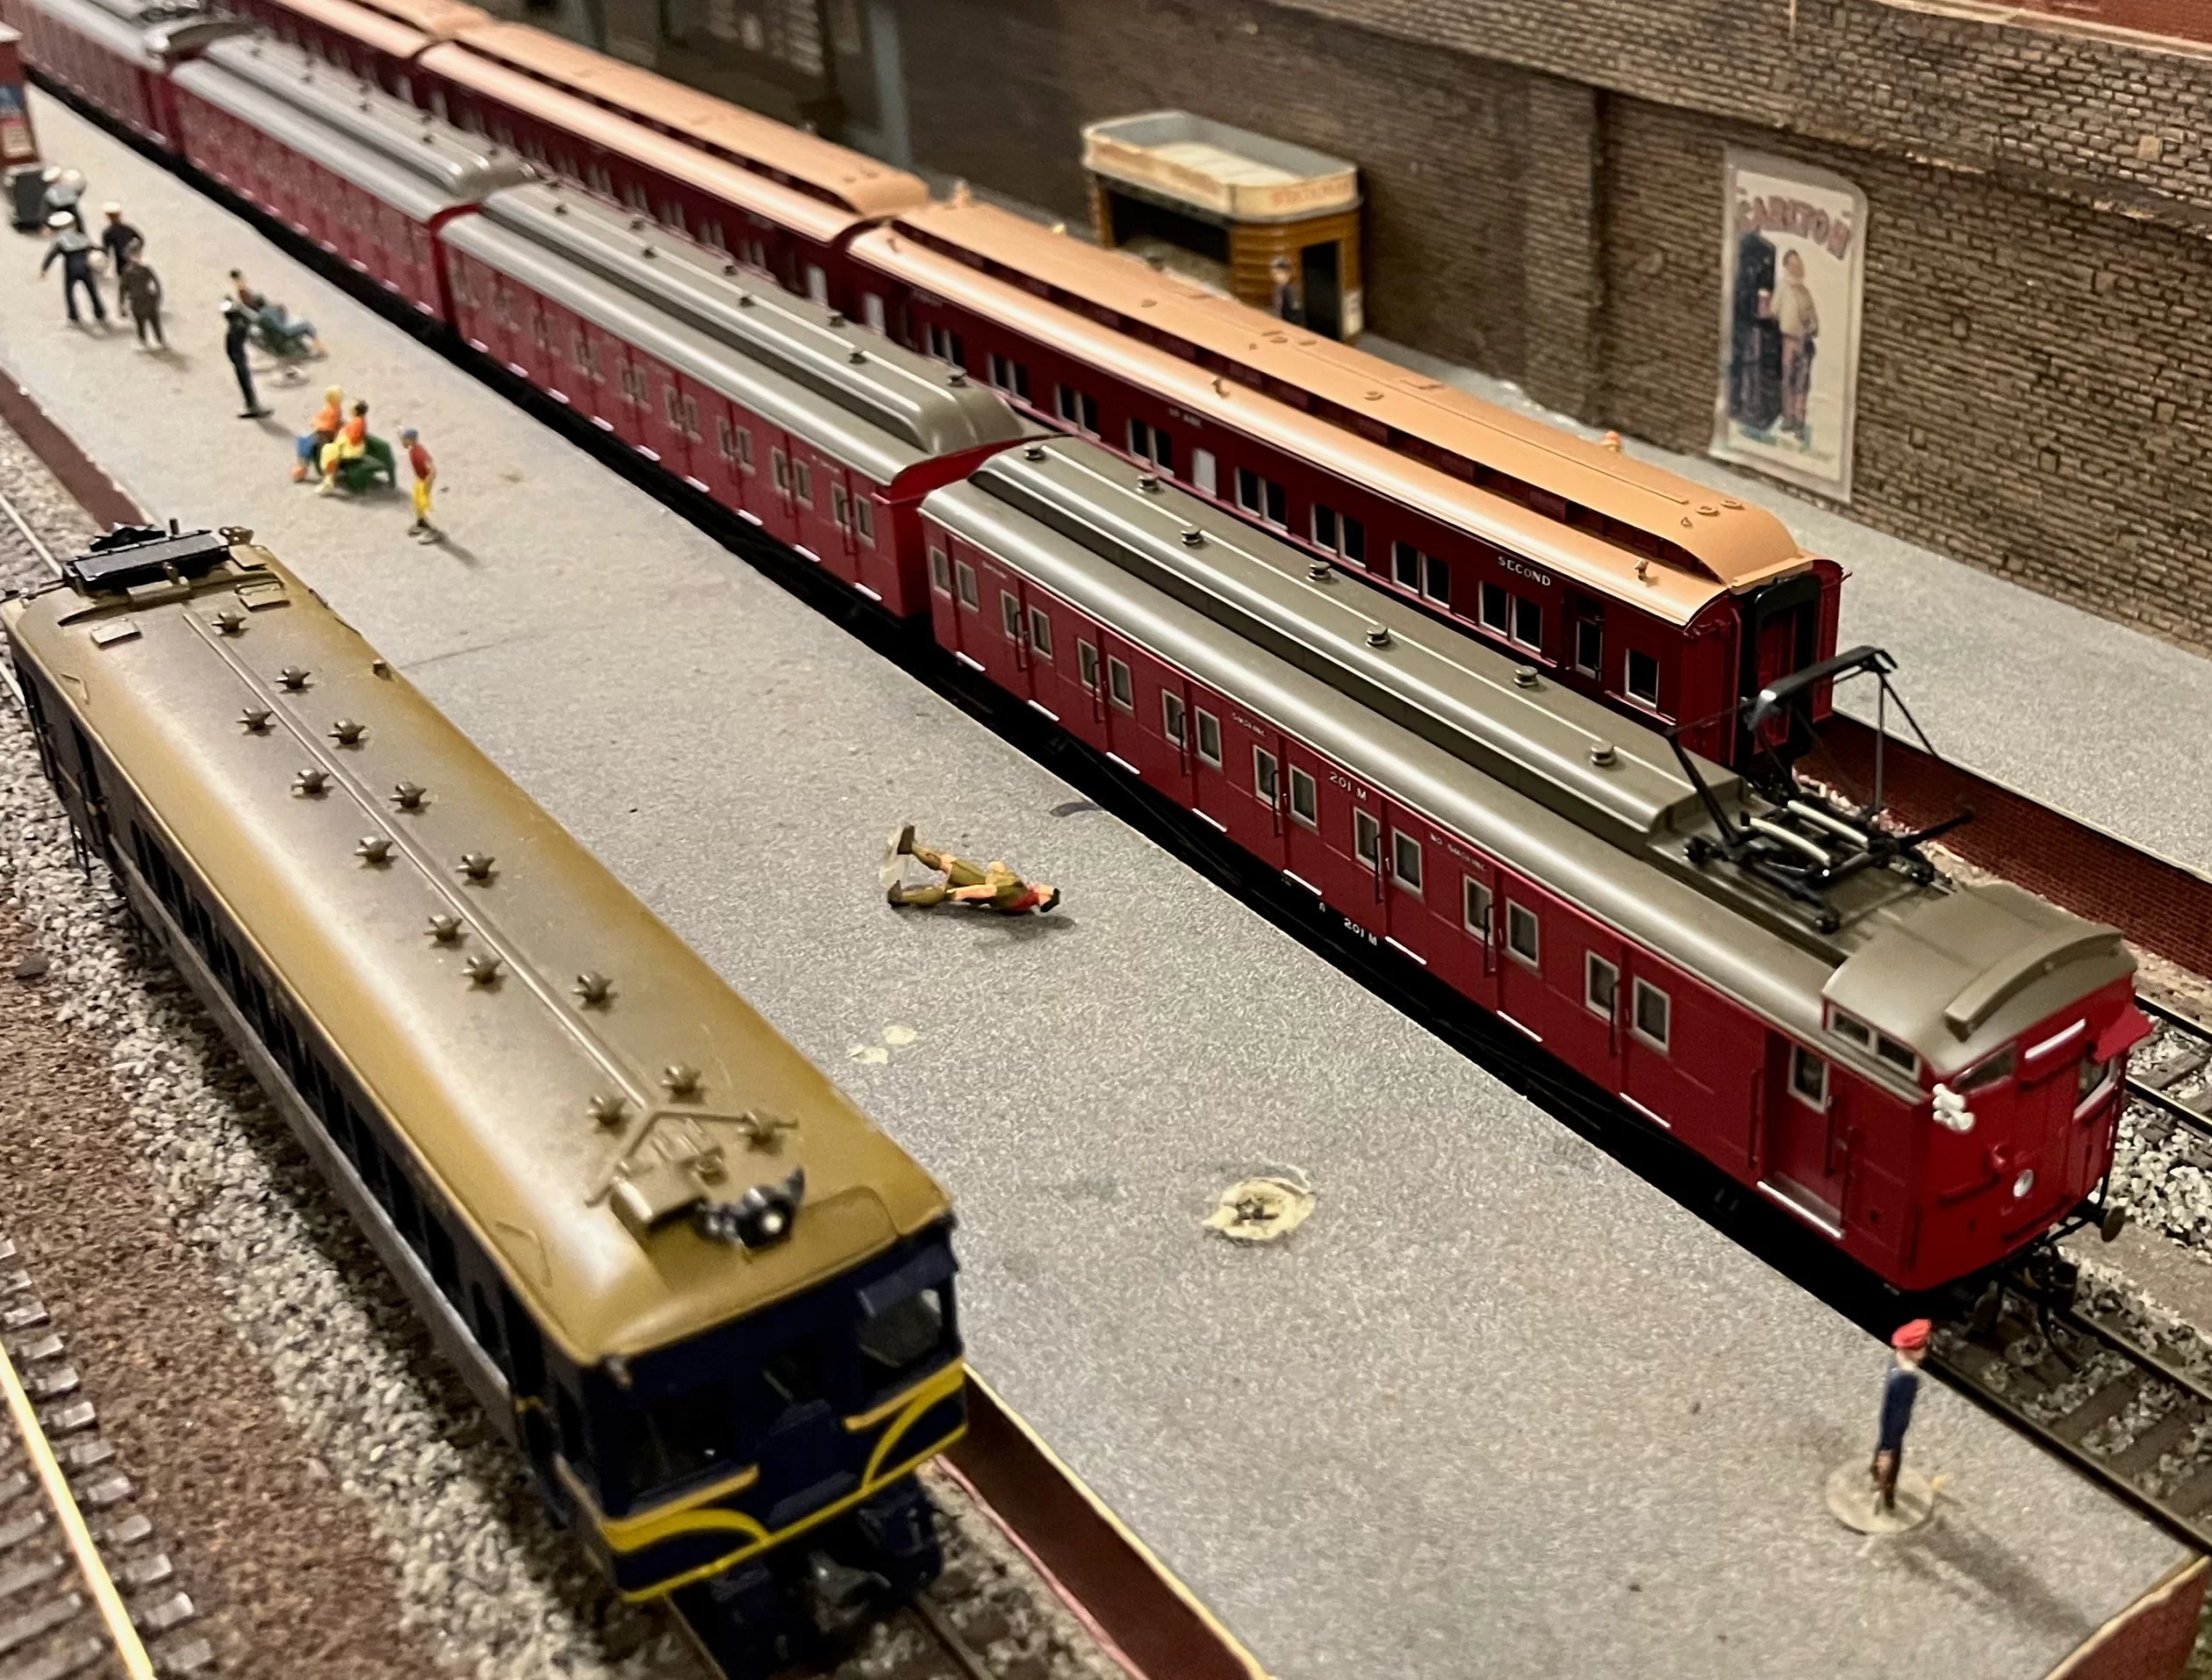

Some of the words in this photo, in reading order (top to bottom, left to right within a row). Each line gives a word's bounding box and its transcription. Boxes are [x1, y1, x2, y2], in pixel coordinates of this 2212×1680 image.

[1497, 556, 1551, 586] SECOND
[1330, 771, 1351, 792] 201
[1357, 787, 1367, 802] M
[1344, 917, 1365, 939] 201
[1368, 932, 1378, 946] M
